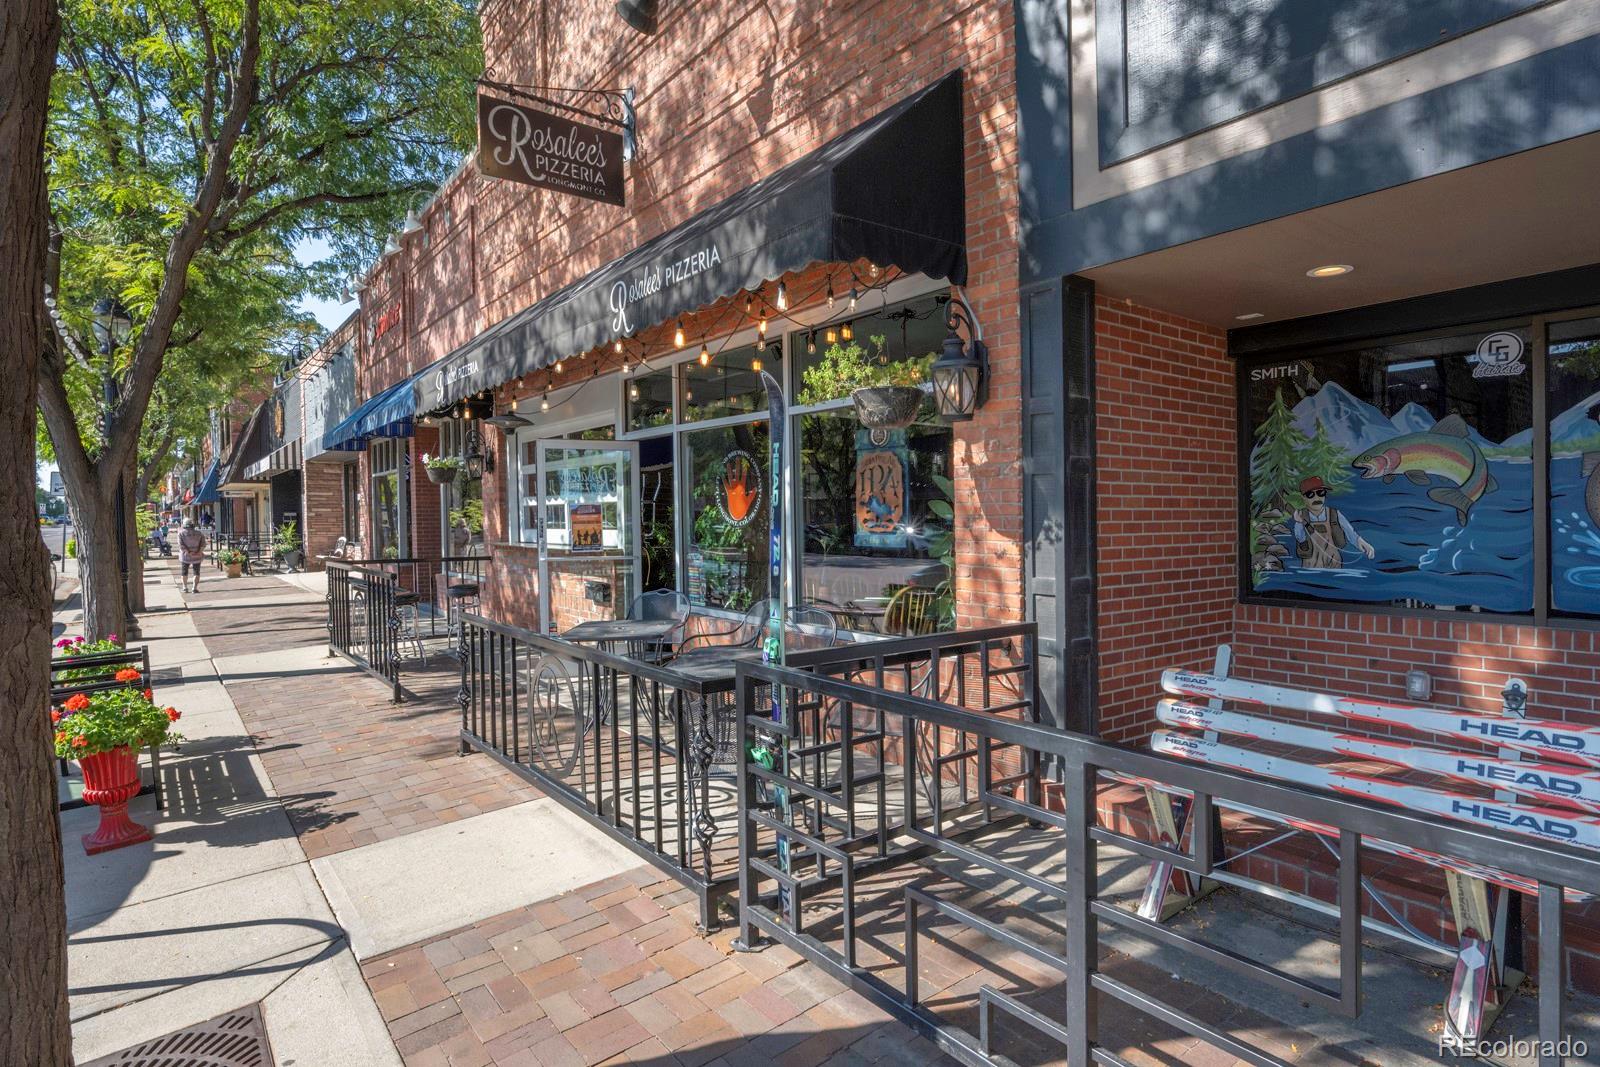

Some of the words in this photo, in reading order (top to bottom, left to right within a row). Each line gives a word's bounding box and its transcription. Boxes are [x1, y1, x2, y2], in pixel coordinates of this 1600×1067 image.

[488, 105, 607, 181] Rosalee's
[536, 154, 606, 186] PIZZERIA
[547, 176, 593, 193] LONGMONT
[610, 265, 661, 333] Rosalee's
[665, 244, 721, 287] PIZZERIA
[1250, 364, 1299, 381] SMITH
[772, 442, 780, 507] HEAD
[1174, 676, 1208, 685] HEAD
[1170, 706, 1204, 717] HEAD
[1165, 737, 1198, 749] HEAD
[1460, 719, 1586, 750] HEAD
[1457, 760, 1582, 794] HEAD
[1452, 800, 1577, 838] HEAD
